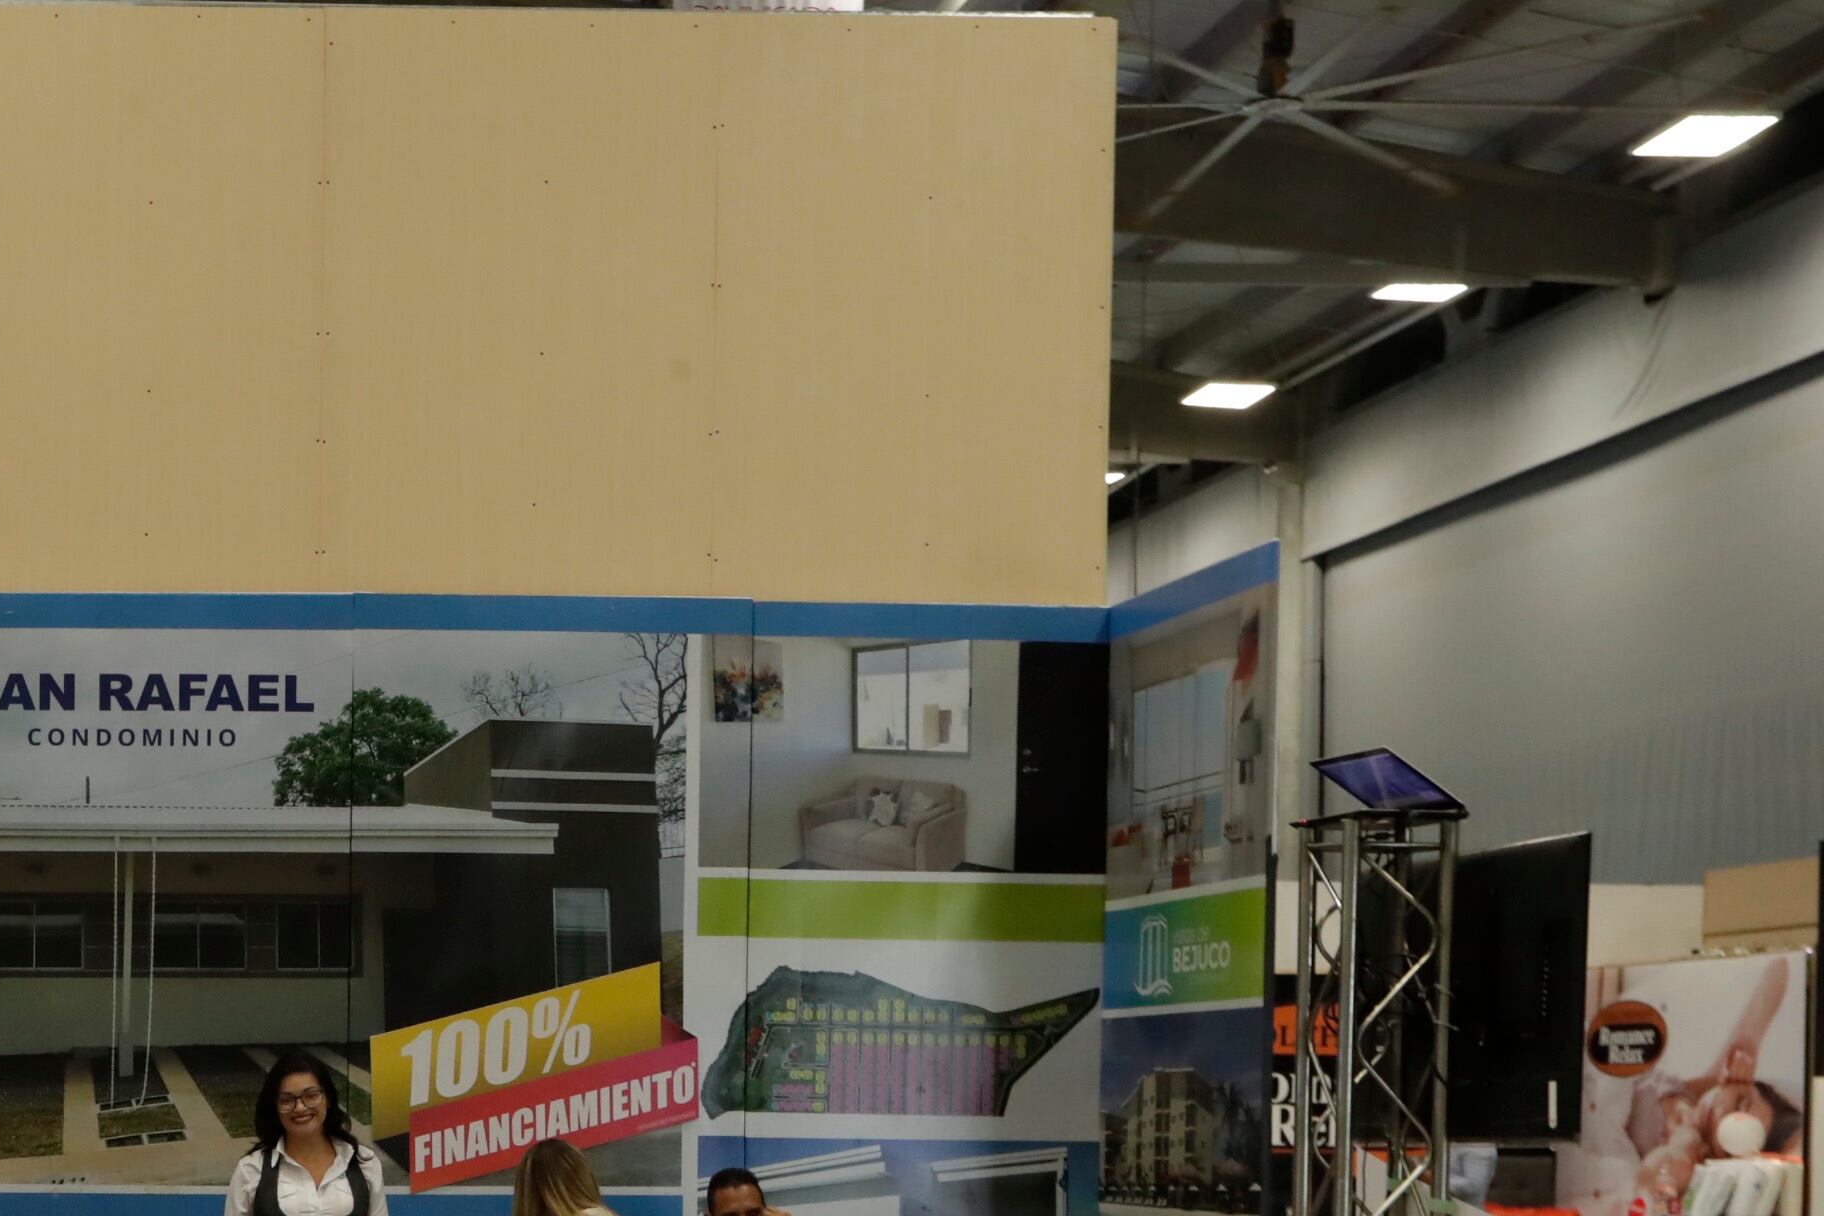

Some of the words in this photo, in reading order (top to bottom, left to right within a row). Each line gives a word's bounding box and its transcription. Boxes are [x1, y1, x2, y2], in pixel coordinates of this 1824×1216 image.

[98, 673, 315, 713] RAFAEL
[27, 728, 236, 747] CONDOMINIO
[1172, 941, 1231, 973] BEJUCO
[400, 989, 592, 1107] 100%
